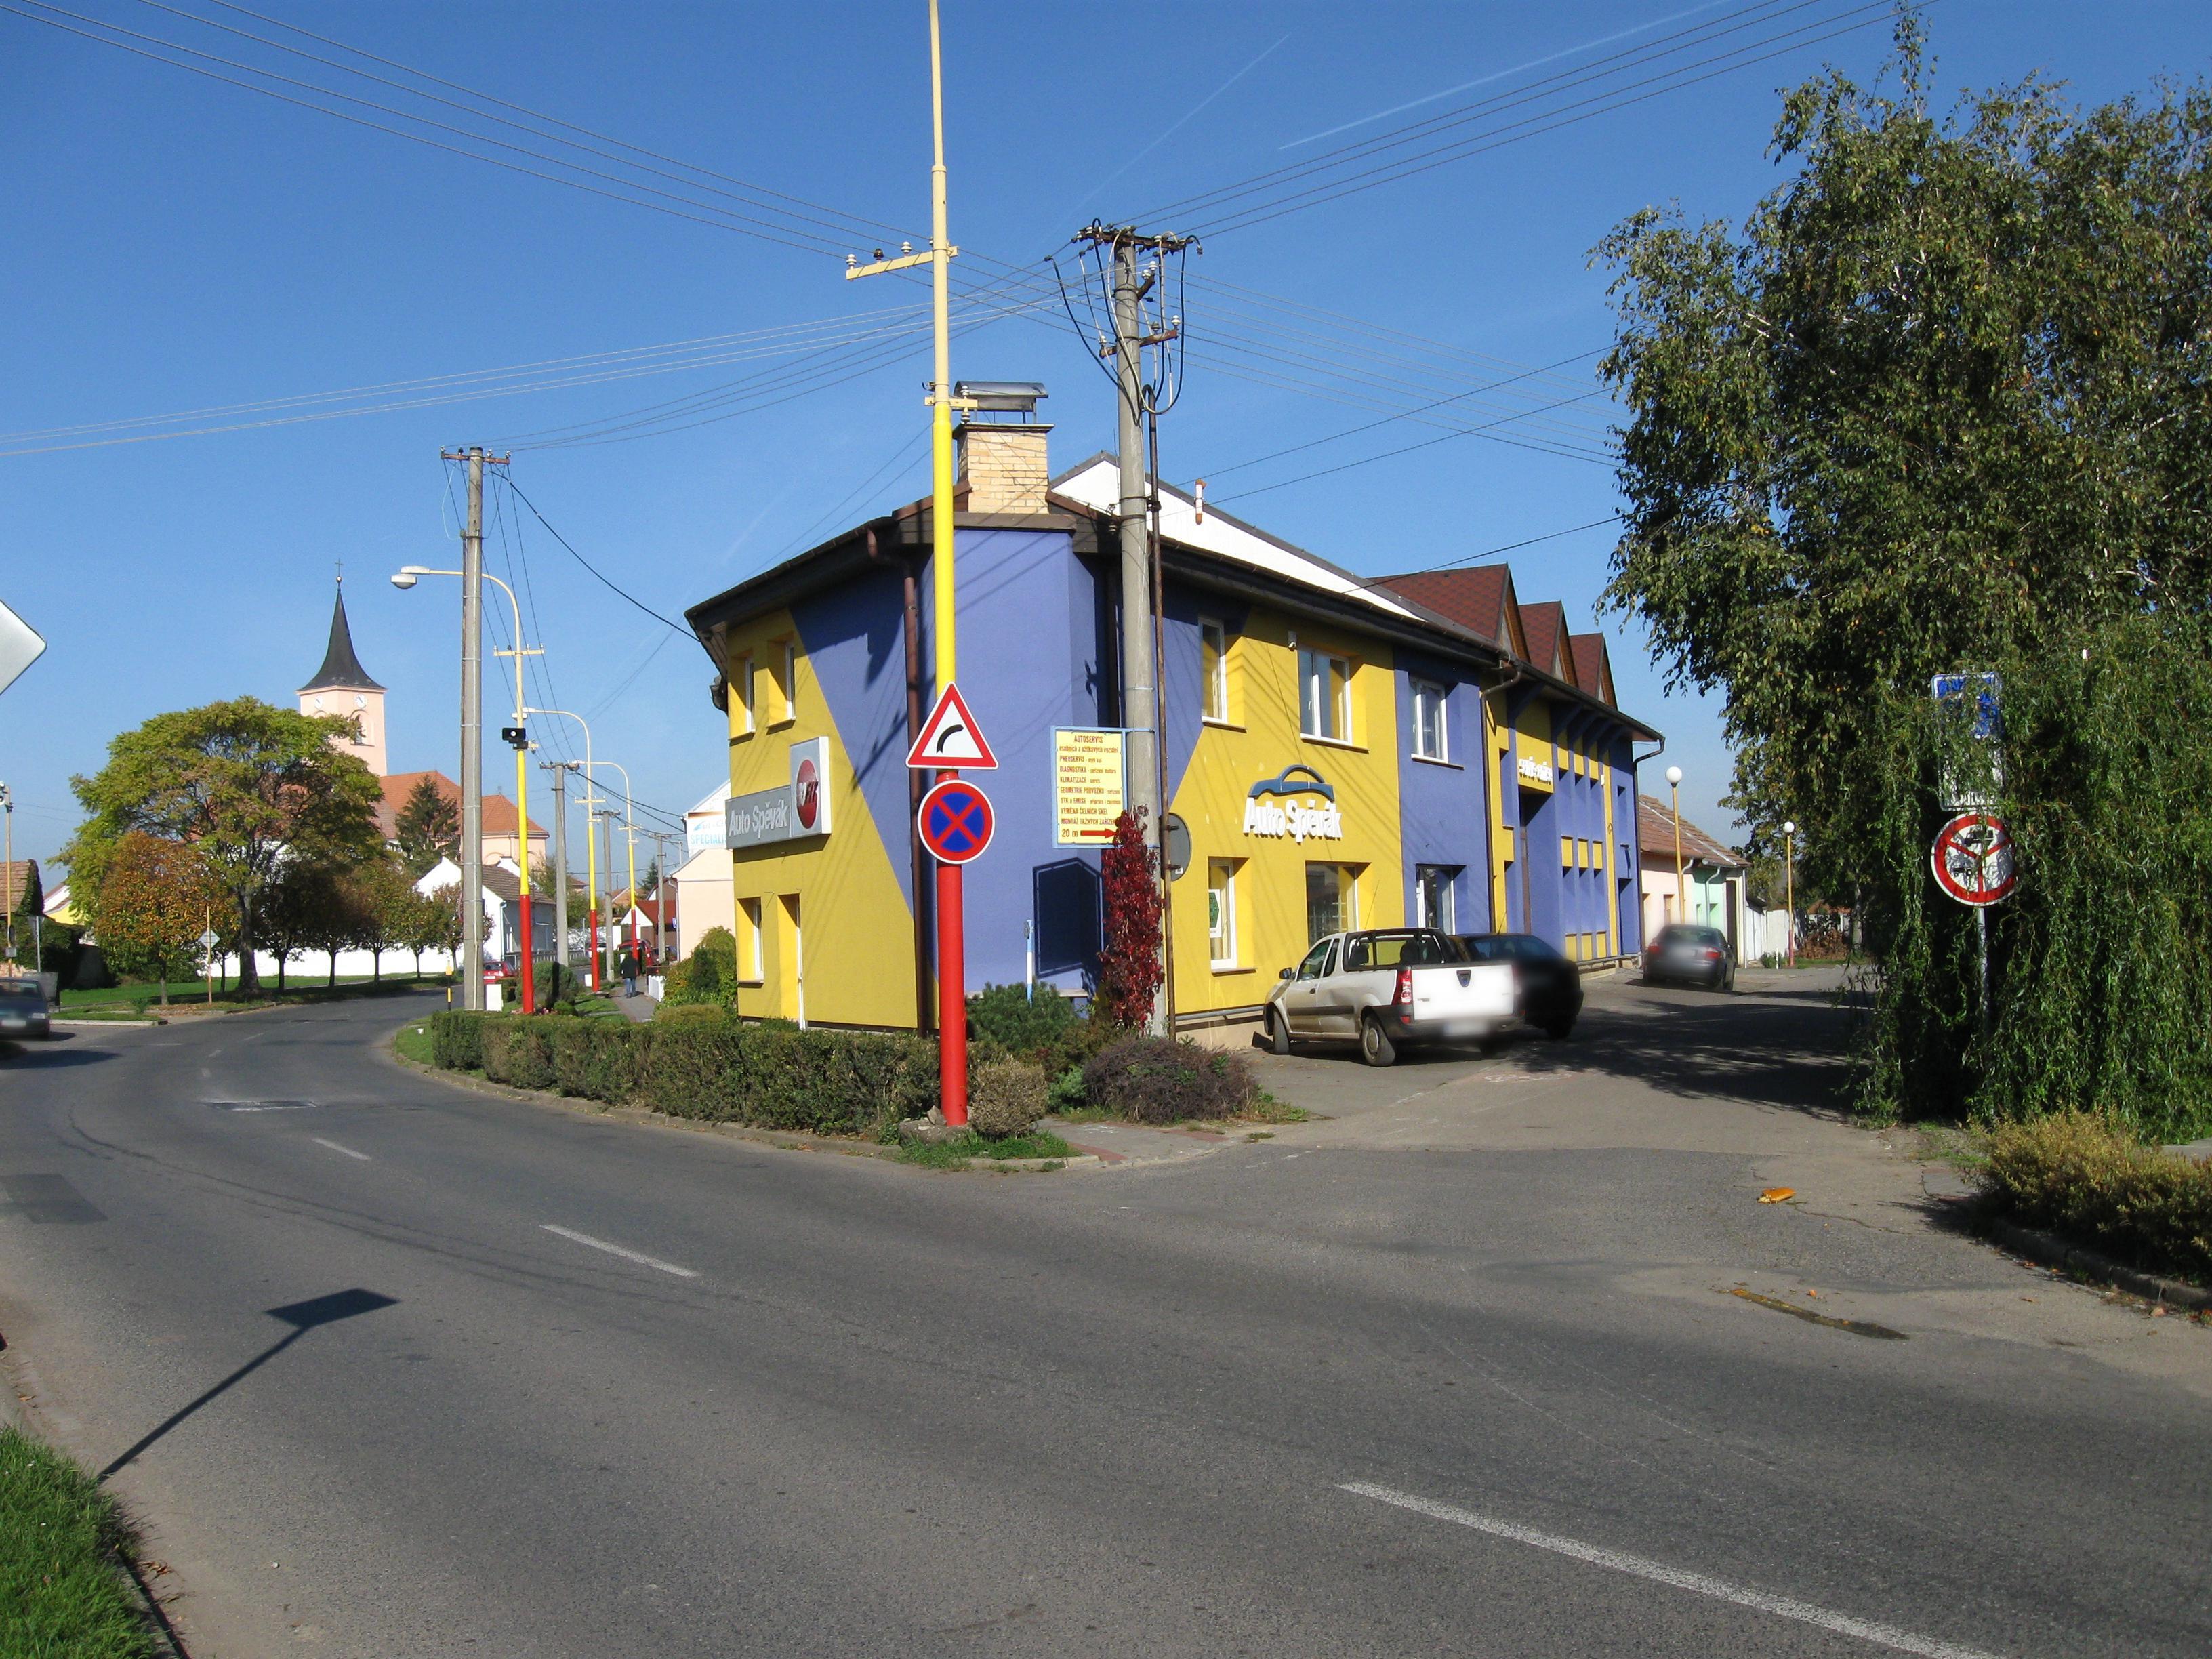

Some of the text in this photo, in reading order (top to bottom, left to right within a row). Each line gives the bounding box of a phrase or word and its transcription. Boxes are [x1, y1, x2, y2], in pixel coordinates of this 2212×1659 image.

[1074, 735, 1103, 743] AUTOSERVIS
[1080, 806, 1097, 815] ČELNÍCH
[729, 808, 750, 836] Auto
[752, 799, 789, 838] Spěvák
[1061, 817, 1079, 825] MONTÁŽ
[1100, 817, 1116, 825] ZAŘÍZEN
[1243, 797, 1343, 842] Auto Spěvák
[1062, 829, 1070, 838] 20
